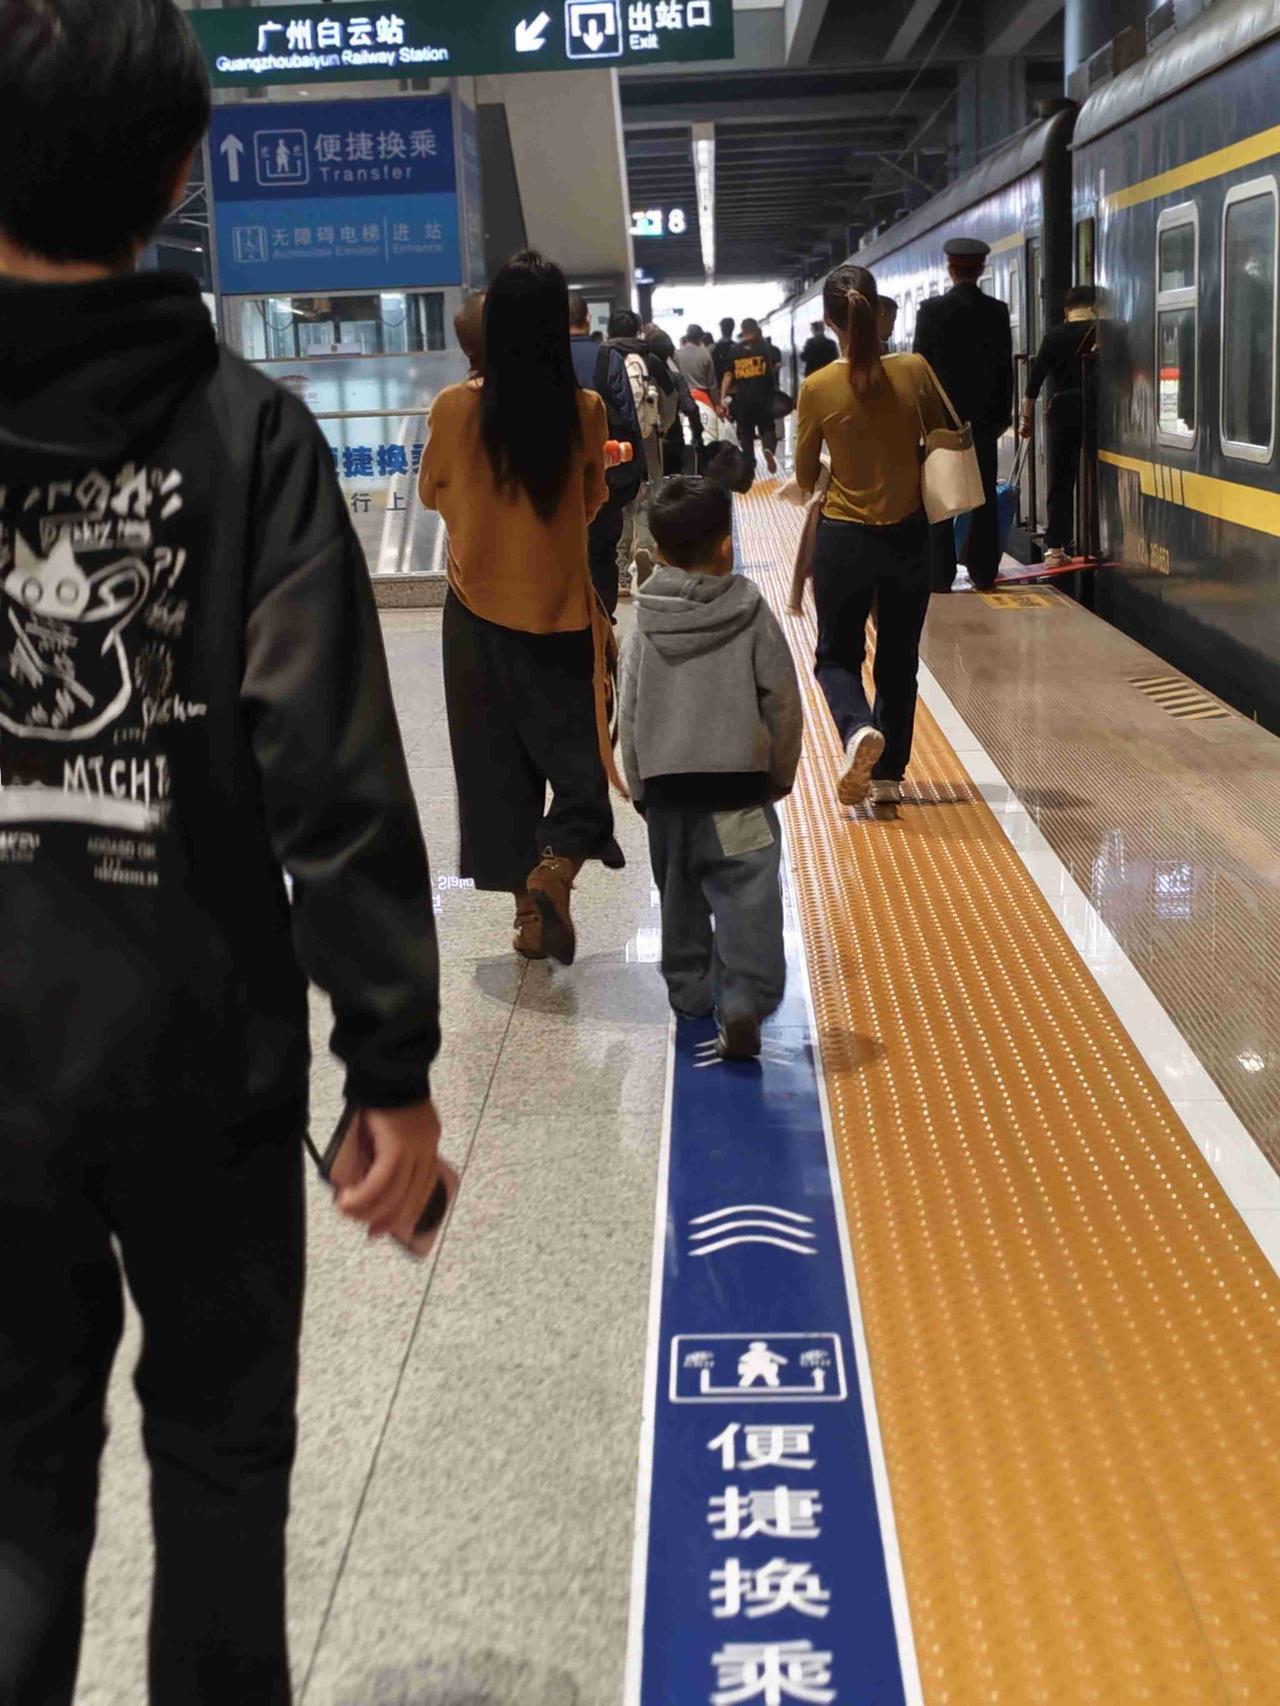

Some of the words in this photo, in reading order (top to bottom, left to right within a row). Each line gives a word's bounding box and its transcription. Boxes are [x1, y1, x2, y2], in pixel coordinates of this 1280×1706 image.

[628, 0, 711, 31] 出站口
[257, 14, 404, 51] 广州白云站
[629, 33, 659, 50] Exit
[216, 53, 340, 72] Guangzhoubaiyun
[341, 49, 395, 66] Railway
[399, 46, 448, 62] Station
[314, 129, 437, 162] 便捷换乘
[320, 165, 413, 182] Transfer
[706, 1422, 837, 1706] 便捷换乘
